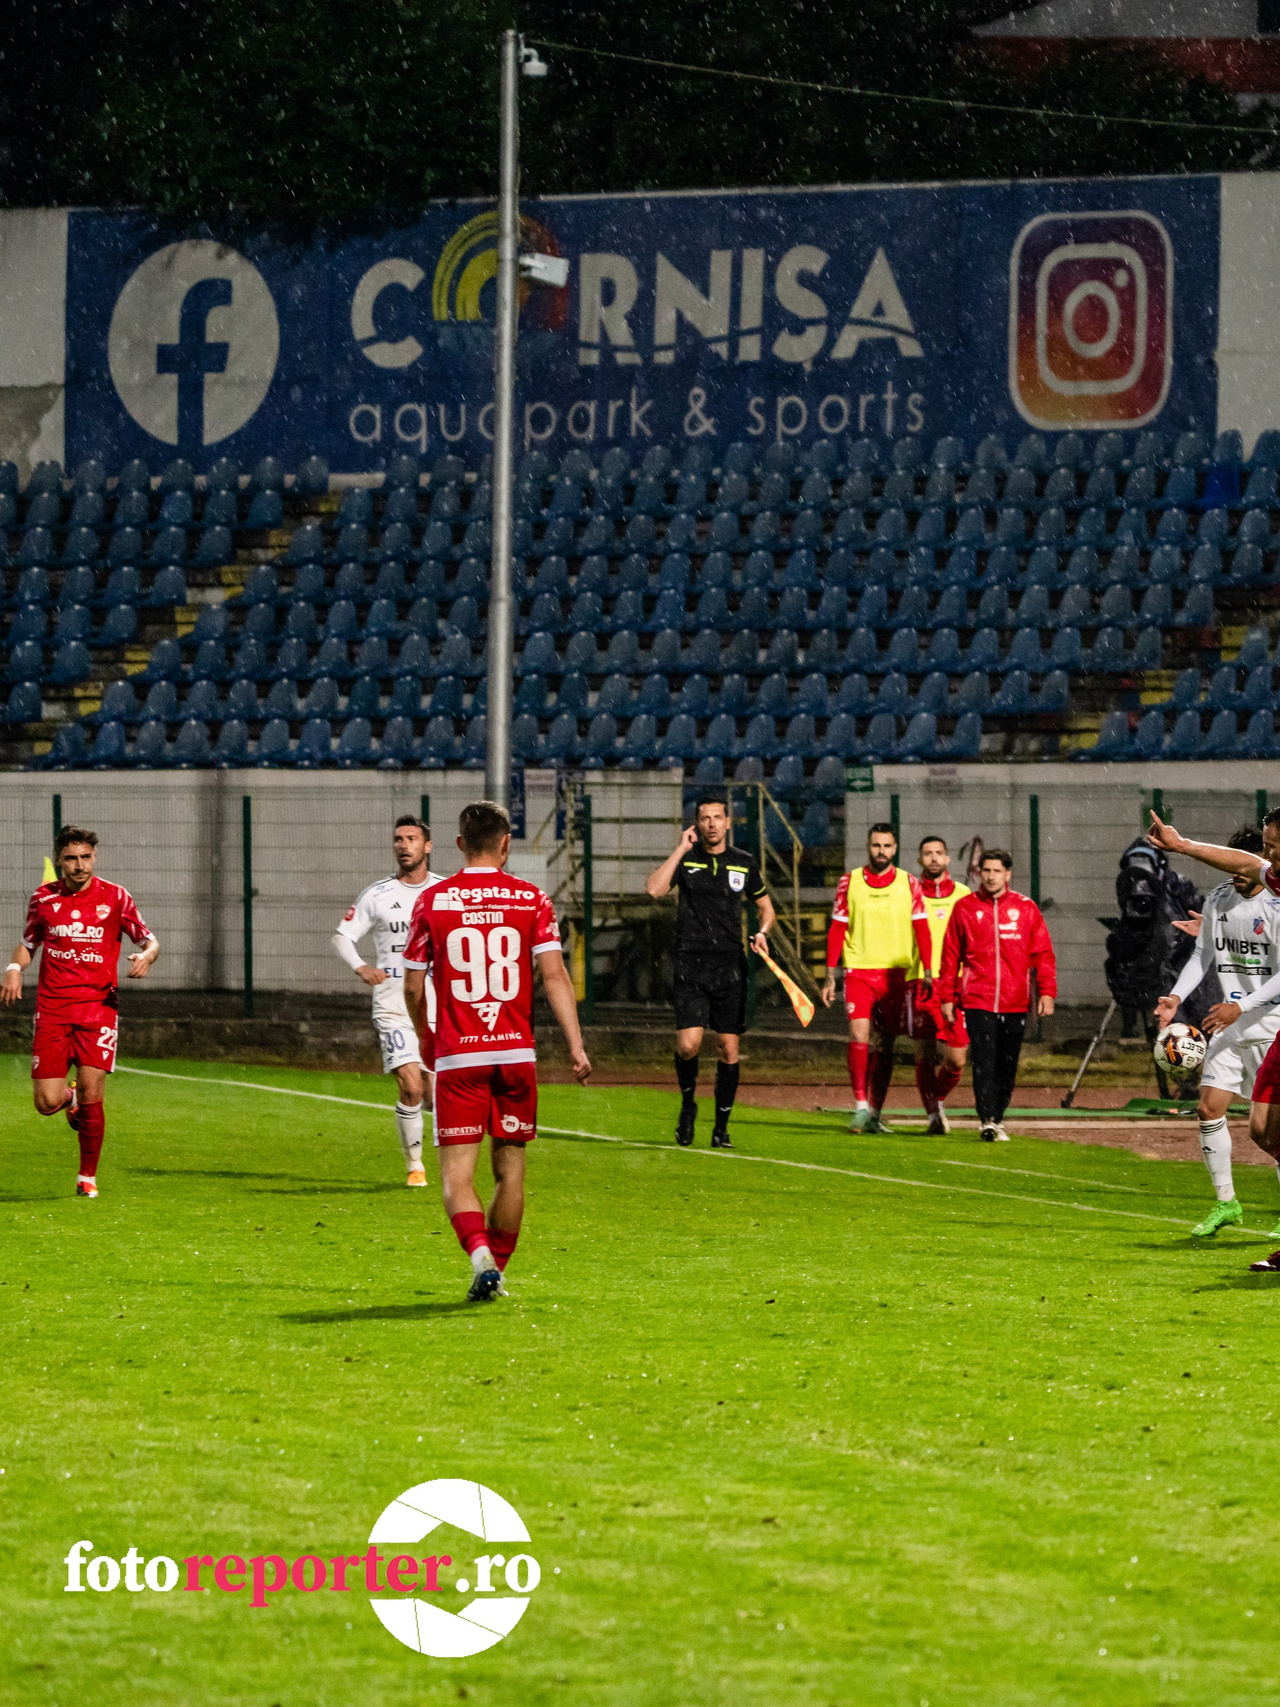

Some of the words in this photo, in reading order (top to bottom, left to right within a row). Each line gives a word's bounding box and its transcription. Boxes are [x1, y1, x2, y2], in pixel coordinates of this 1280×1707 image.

[682, 386, 718, 437] &
[746, 381, 926, 445] sports
[447, 886, 535, 903] Regata.ro
[1215, 937, 1270, 956] UNIBET
[446, 926, 521, 1002] 98
[481, 1032, 522, 1042] GAMING
